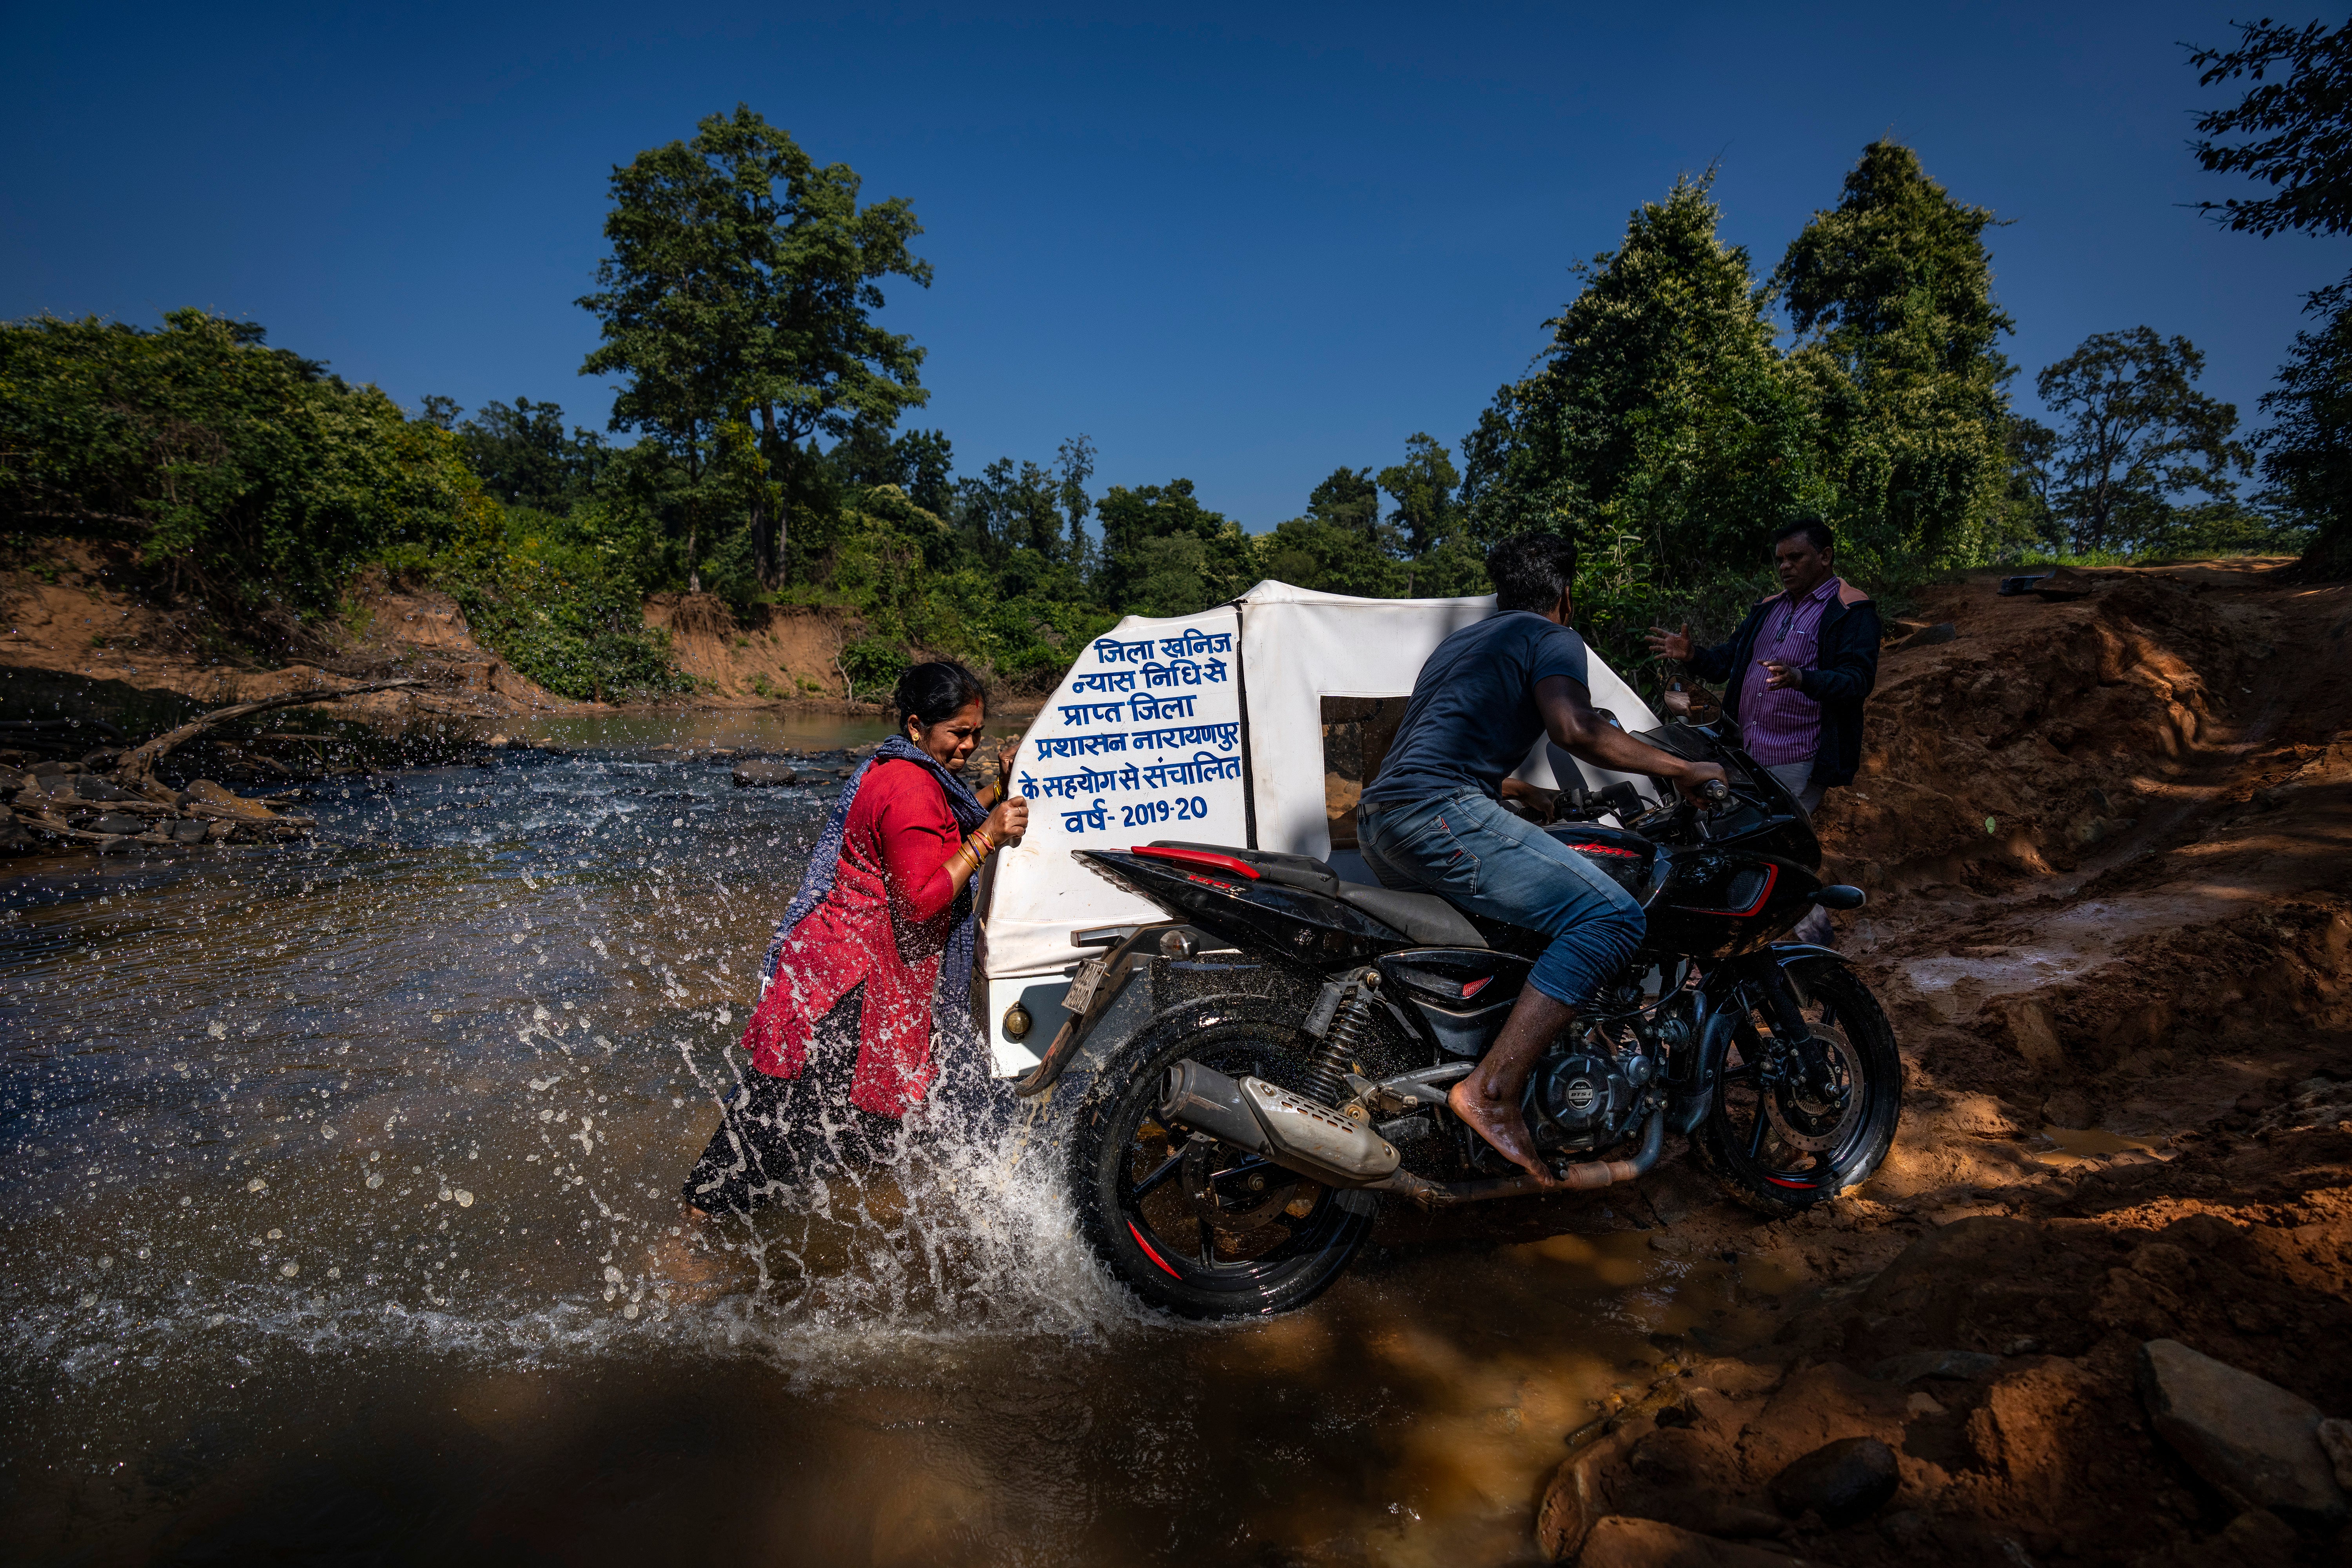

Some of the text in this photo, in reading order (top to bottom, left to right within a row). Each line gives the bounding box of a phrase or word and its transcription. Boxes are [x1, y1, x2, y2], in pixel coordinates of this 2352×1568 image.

[1093, 628, 1232, 664] जिला खनिज
[1072, 670, 1136, 694] न्यास
[1058, 692, 1198, 726] प्राप्त जिला
[1035, 721, 1240, 761] प्रशासन नारायणपुर
[1018, 751, 1241, 800] के सहयोग से संचालित
[1121, 796, 1208, 828] 2019-20
[1564, 840, 1641, 858] ulsar
